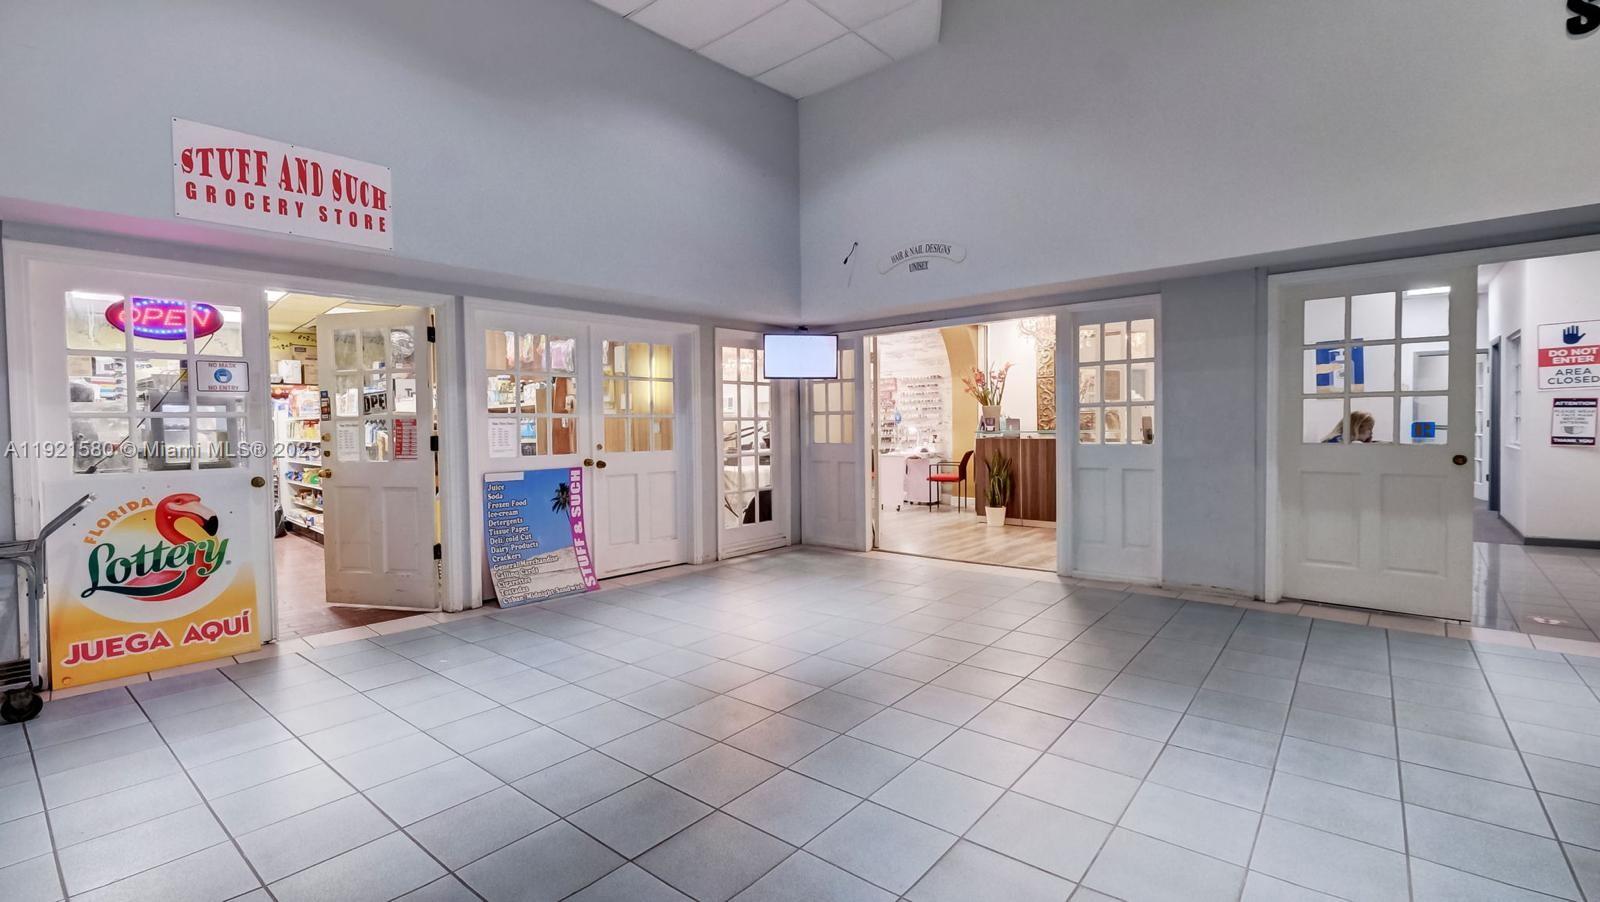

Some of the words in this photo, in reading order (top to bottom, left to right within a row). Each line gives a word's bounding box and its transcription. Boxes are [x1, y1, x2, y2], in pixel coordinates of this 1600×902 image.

[181, 147, 268, 187] STUFF
[278, 154, 324, 197] AND
[332, 168, 387, 211] SUCH
[185, 181, 304, 219] GROCERY
[319, 205, 386, 233] STORE
[890, 250, 904, 264] HAIR
[909, 244, 923, 255] NAIL
[925, 243, 952, 255] DESIGNS
[908, 261, 929, 272] UNISEX
[118, 307, 211, 327] OPEN
[1548, 349, 1567, 357] DO
[1571, 346, 1599, 355] NOT
[1552, 355, 1595, 364] ENTER
[1555, 367, 1592, 376] AREA
[1547, 375, 1600, 385] CLOSED
[363, 392, 387, 414] OPE
[570, 470, 582, 518] SUCH
[487, 501, 510, 509] Frozen
[511, 499, 527, 507] Food
[82, 497, 153, 545] FLORIDA
[488, 518, 523, 527] Detergents
[511, 526, 529, 534] Paper
[573, 521, 582, 534] &
[520, 533, 533, 541] Cut
[490, 545, 509, 554] Dairy
[510, 542, 539, 552] Products
[491, 552, 521, 563] Crackers
[574, 538, 596, 587] STUFF
[81, 538, 229, 598] Lottery
[64, 630, 171, 665] JUEGA
[183, 611, 250, 643] AQUÍ
